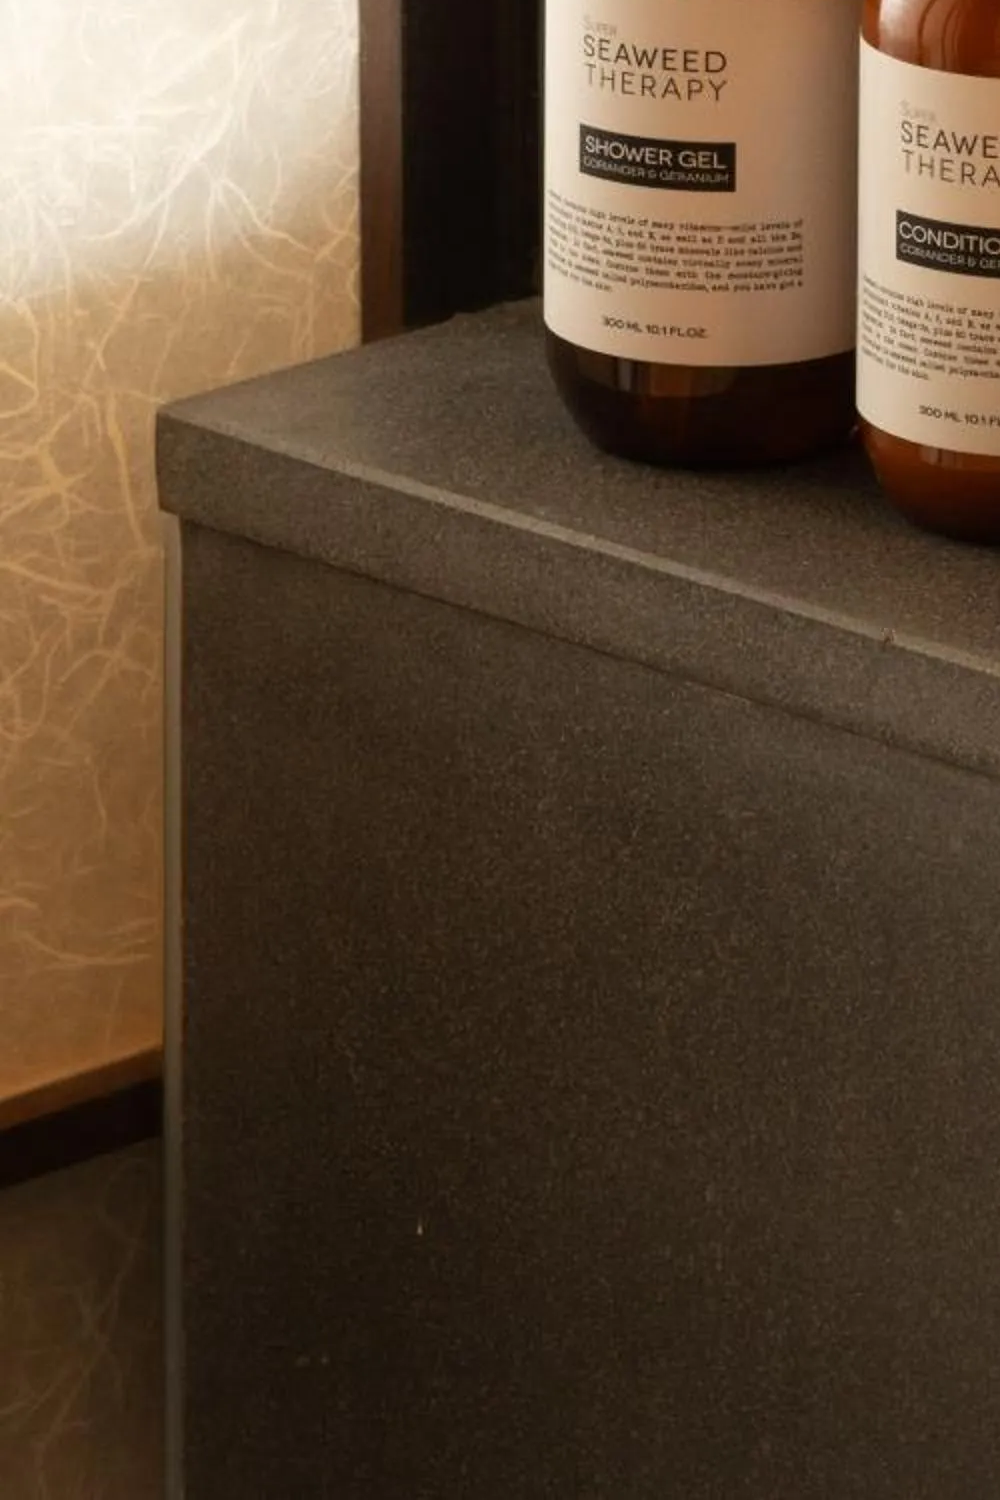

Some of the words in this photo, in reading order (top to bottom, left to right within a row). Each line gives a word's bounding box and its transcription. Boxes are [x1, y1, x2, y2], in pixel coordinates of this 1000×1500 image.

[584, 34, 727, 73] SEAWEED
[584, 63, 728, 101] THERAPY
[585, 135, 672, 166] SHOWER
[678, 151, 728, 169] GEL
[584, 156, 645, 178] CORIANDER
[659, 171, 729, 184] GERANIUM
[900, 242, 965, 265] CORIANDER
[919, 404, 942, 419] 300
[944, 412, 961, 423] ML
